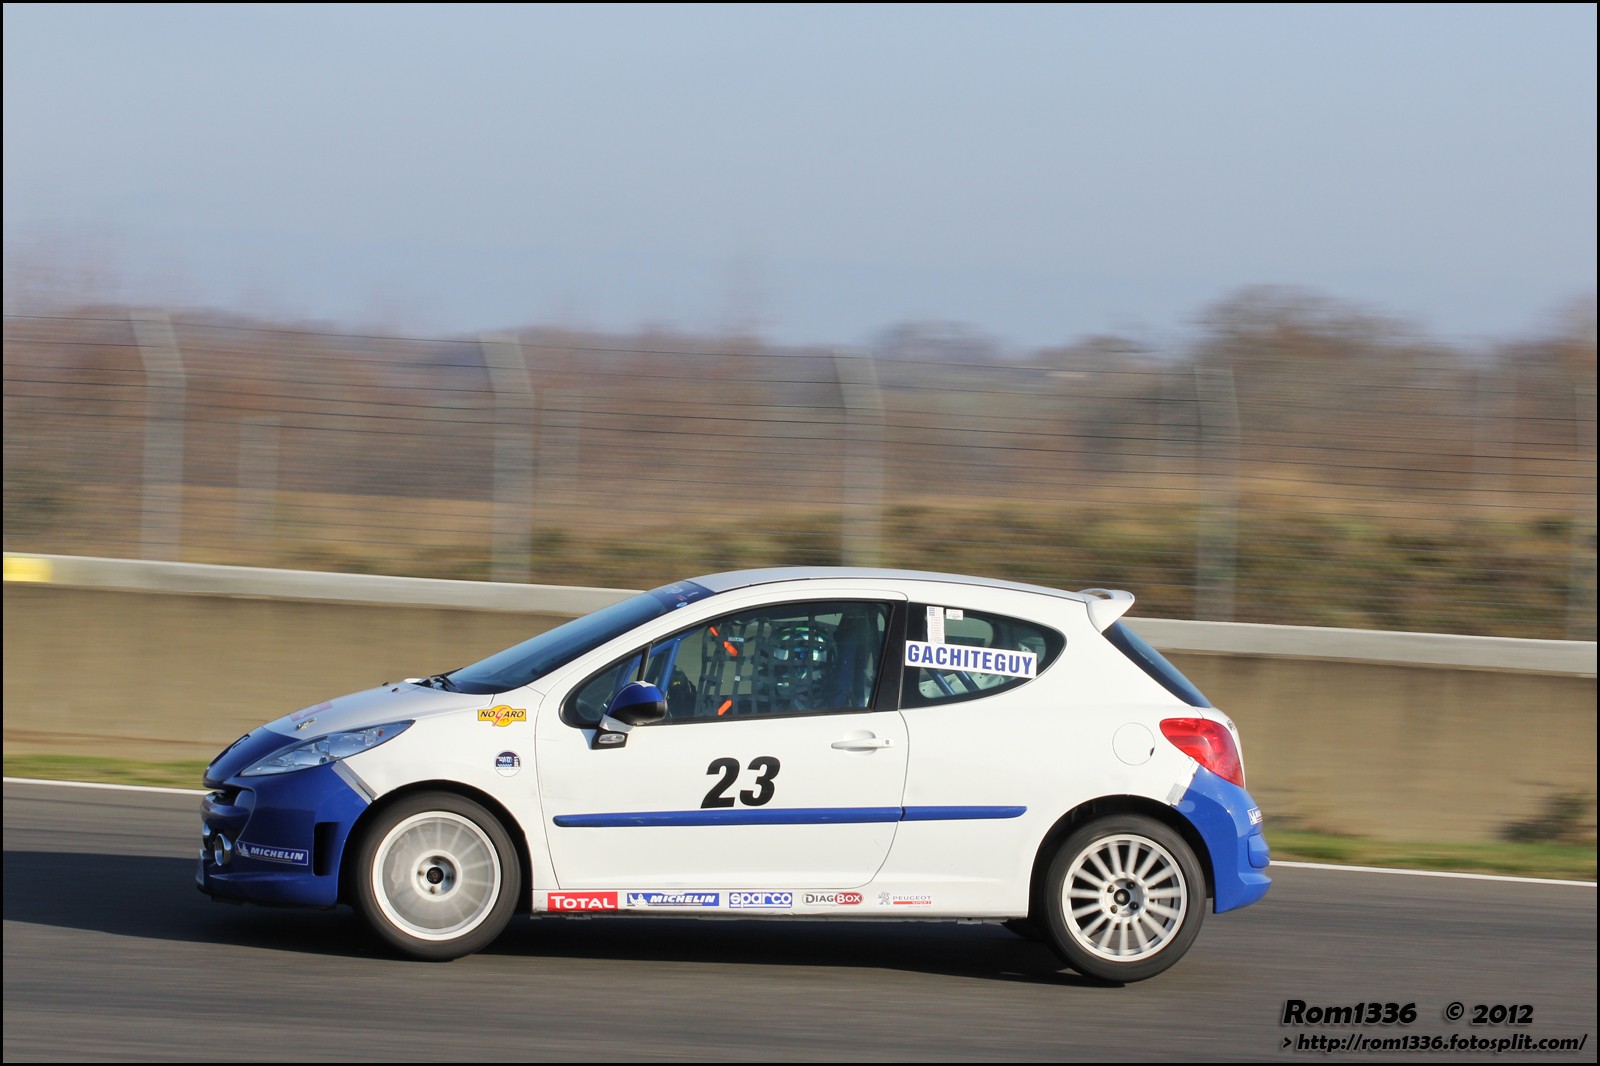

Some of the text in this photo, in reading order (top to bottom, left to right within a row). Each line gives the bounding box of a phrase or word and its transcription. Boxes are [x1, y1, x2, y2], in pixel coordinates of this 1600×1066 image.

[907, 644, 1033, 675] GACHITEGUY
[480, 707, 524, 727] NOGARO
[700, 755, 781, 809] 23
[250, 846, 304, 861] MICHELIN
[649, 894, 716, 903] MICHELIN
[730, 892, 792, 908] sparco
